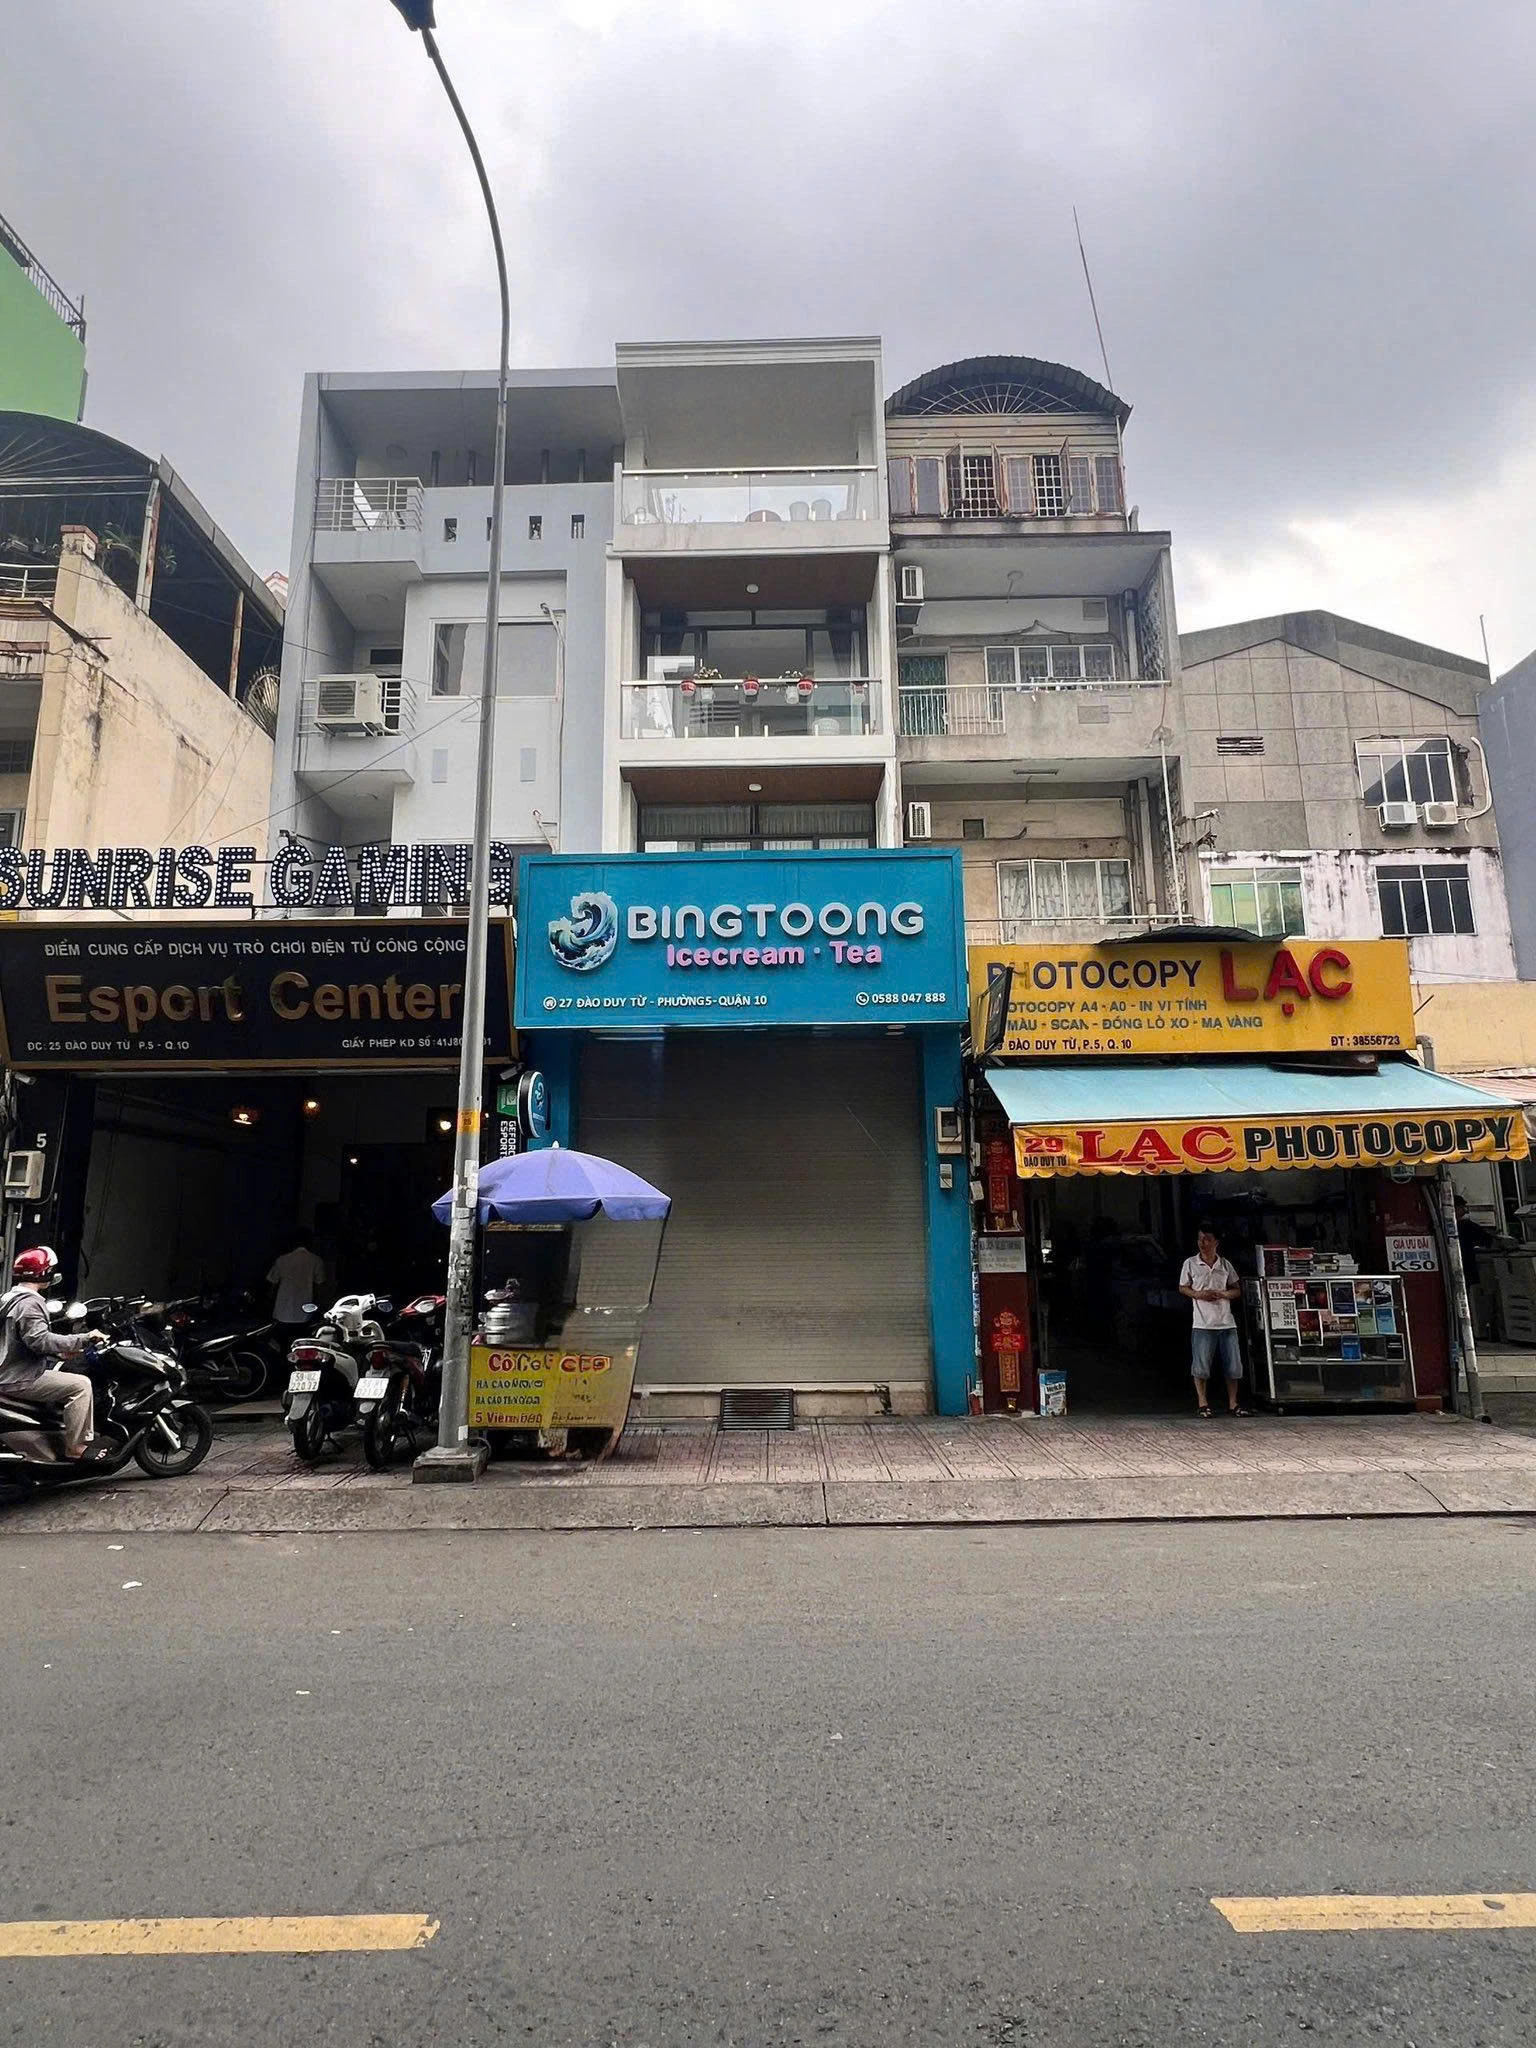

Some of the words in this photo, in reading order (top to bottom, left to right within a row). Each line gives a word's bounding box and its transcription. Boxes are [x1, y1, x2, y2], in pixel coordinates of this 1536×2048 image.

[0, 846, 256, 908] SUNRISE
[271, 842, 513, 905] GAMING
[627, 902, 924, 939] BINGTOONG
[44, 939, 81, 956] ĐIỂM
[88, 943, 128, 956] CUNG
[133, 939, 163, 955] CẤP
[169, 942, 202, 958] DỊCH
[208, 942, 228, 958] VỤ
[233, 938, 264, 955] TRÒ
[270, 939, 305, 954] CHƠI
[311, 940, 345, 956] ĐIỆN
[350, 937, 370, 953] TỬ
[376, 938, 418, 953] CÔNG
[424, 937, 465, 954] CỘNG
[666, 944, 805, 967] Icecream
[829, 941, 882, 965] Tea
[1219, 949, 1353, 1017] LẠC
[44, 974, 246, 1034] Esport
[269, 970, 463, 1021] Center
[559, 998, 572, 1008] 27
[576, 995, 600, 1008] ĐÀO
[603, 998, 626, 1008] DUY
[630, 995, 648, 1008] TỪ
[754, 995, 768, 1006] 10
[872, 993, 899, 1004] 0588
[901, 993, 922, 1003] 047
[925, 992, 946, 1003] 888
[1008, 1001, 1075, 1014] OTOCOPY
[1081, 1000, 1099, 1012] A4
[1139, 1000, 1153, 1011] IN
[1158, 1000, 1171, 1011] VI
[1175, 997, 1207, 1011] TÍNH
[1008, 1017, 1037, 1031] MÀU
[1051, 1019, 1089, 1030] SCAN
[1102, 1016, 1143, 1029] ĐÓNG
[1148, 1015, 1165, 1029] LÒ
[1171, 1018, 1189, 1028] XO
[1202, 1018, 1223, 1031] MẠ
[1226, 1015, 1263, 1028] VÀNG
[49, 1042, 61, 1051] 25
[65, 1040, 88, 1051] ĐÀO
[91, 1042, 112, 1051] DUY
[138, 1042, 154, 1051] P.5
[400, 1039, 415, 1047] KD
[1008, 1037, 1030, 1051] ĐÀO
[1036, 1040, 1056, 1051] DUY
[1352, 1035, 1400, 1046] 38556723
[36, 1133, 47, 1148] 5
[500, 1121, 508, 1158] ESPORT
[508, 1121, 517, 1156] GEFORC
[1025, 1137, 1064, 1154] 29
[1076, 1126, 1237, 1172] LẠC
[1243, 1116, 1514, 1162] PHOTOCOPY
[1040, 1155, 1055, 1167] DUY
[1391, 1260, 1436, 1271] K50
